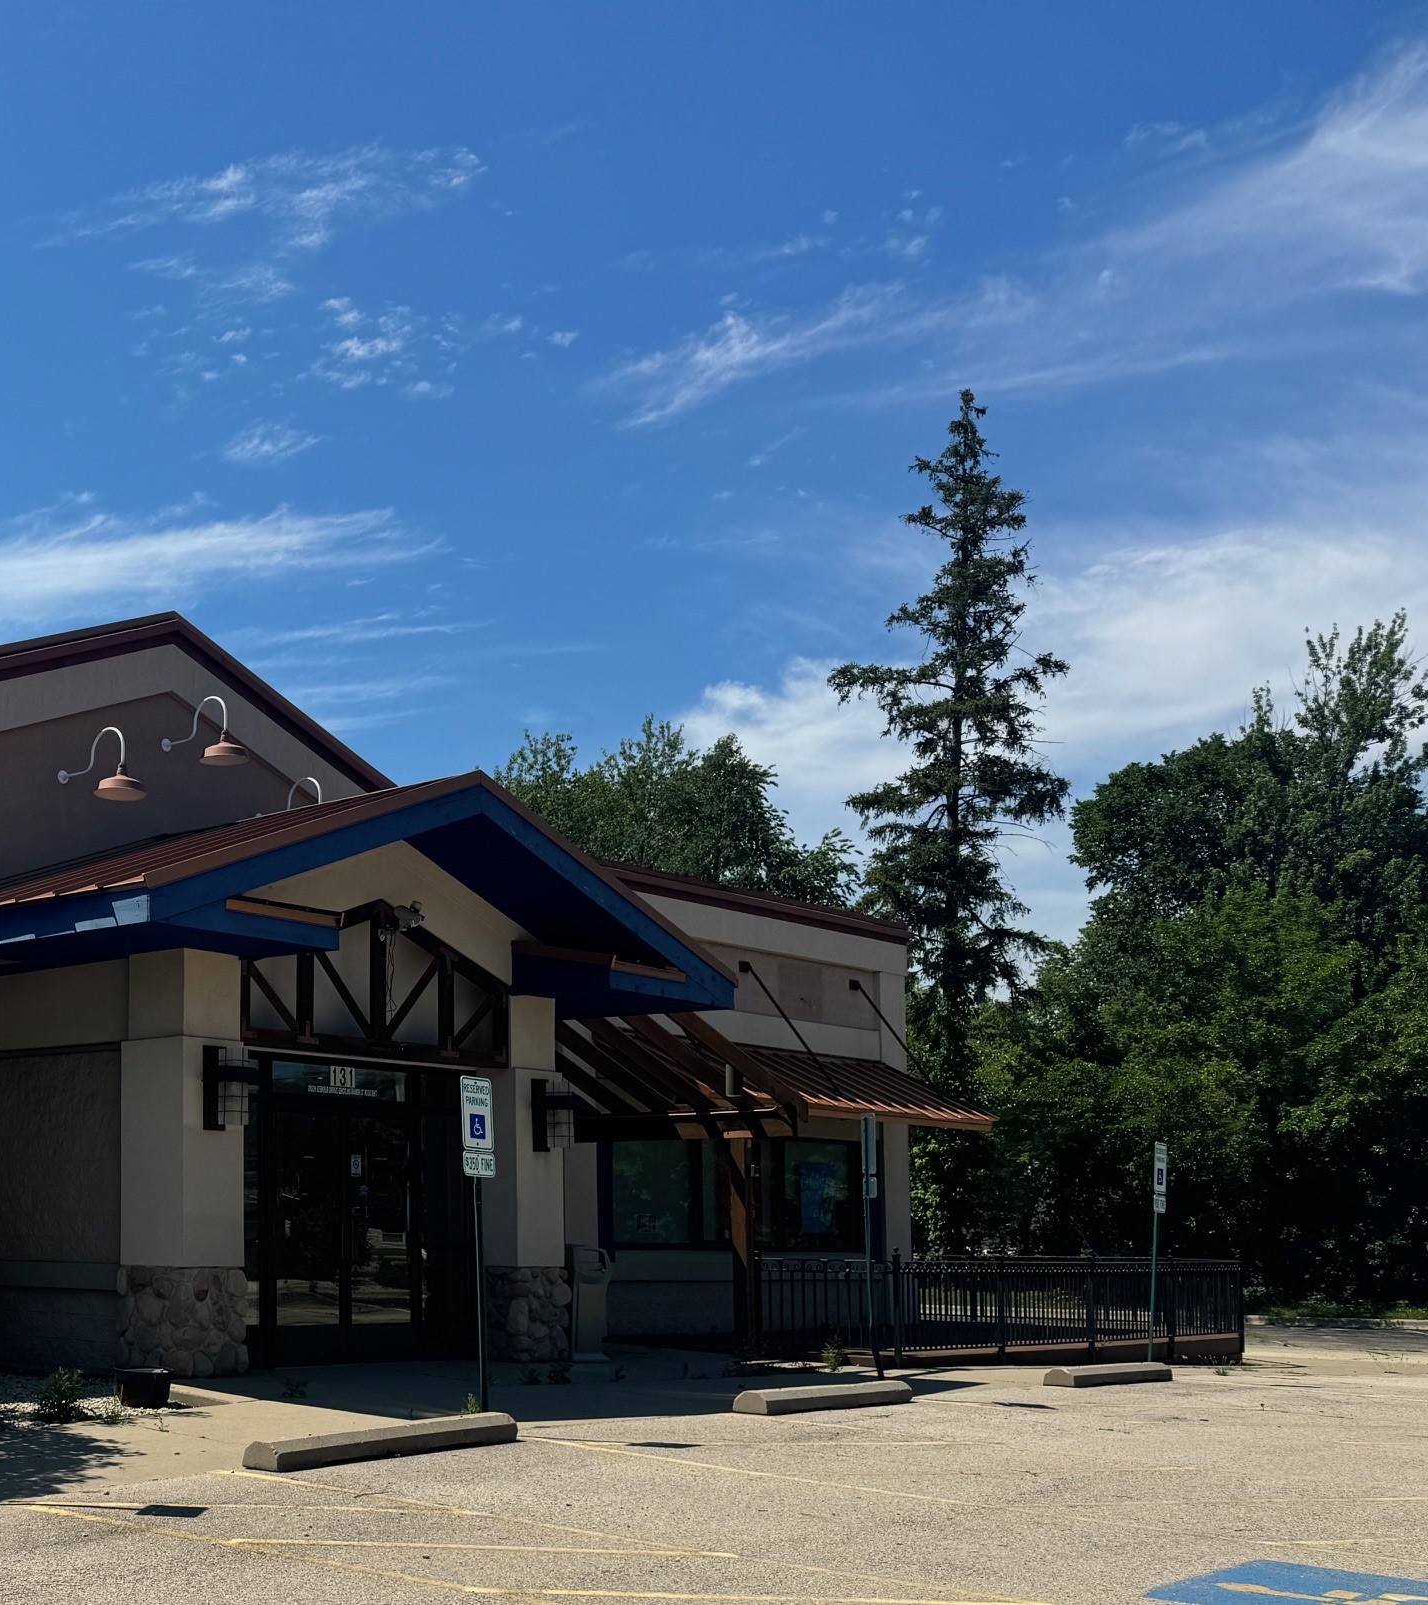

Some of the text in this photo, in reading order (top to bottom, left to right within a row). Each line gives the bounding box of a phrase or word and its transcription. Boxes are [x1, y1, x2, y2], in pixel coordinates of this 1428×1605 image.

[332, 1067, 353, 1087] 131
[463, 1083, 490, 1096] RESERVED
[465, 1095, 489, 1108] PARKING
[465, 1157, 494, 1172] $350 FINE
